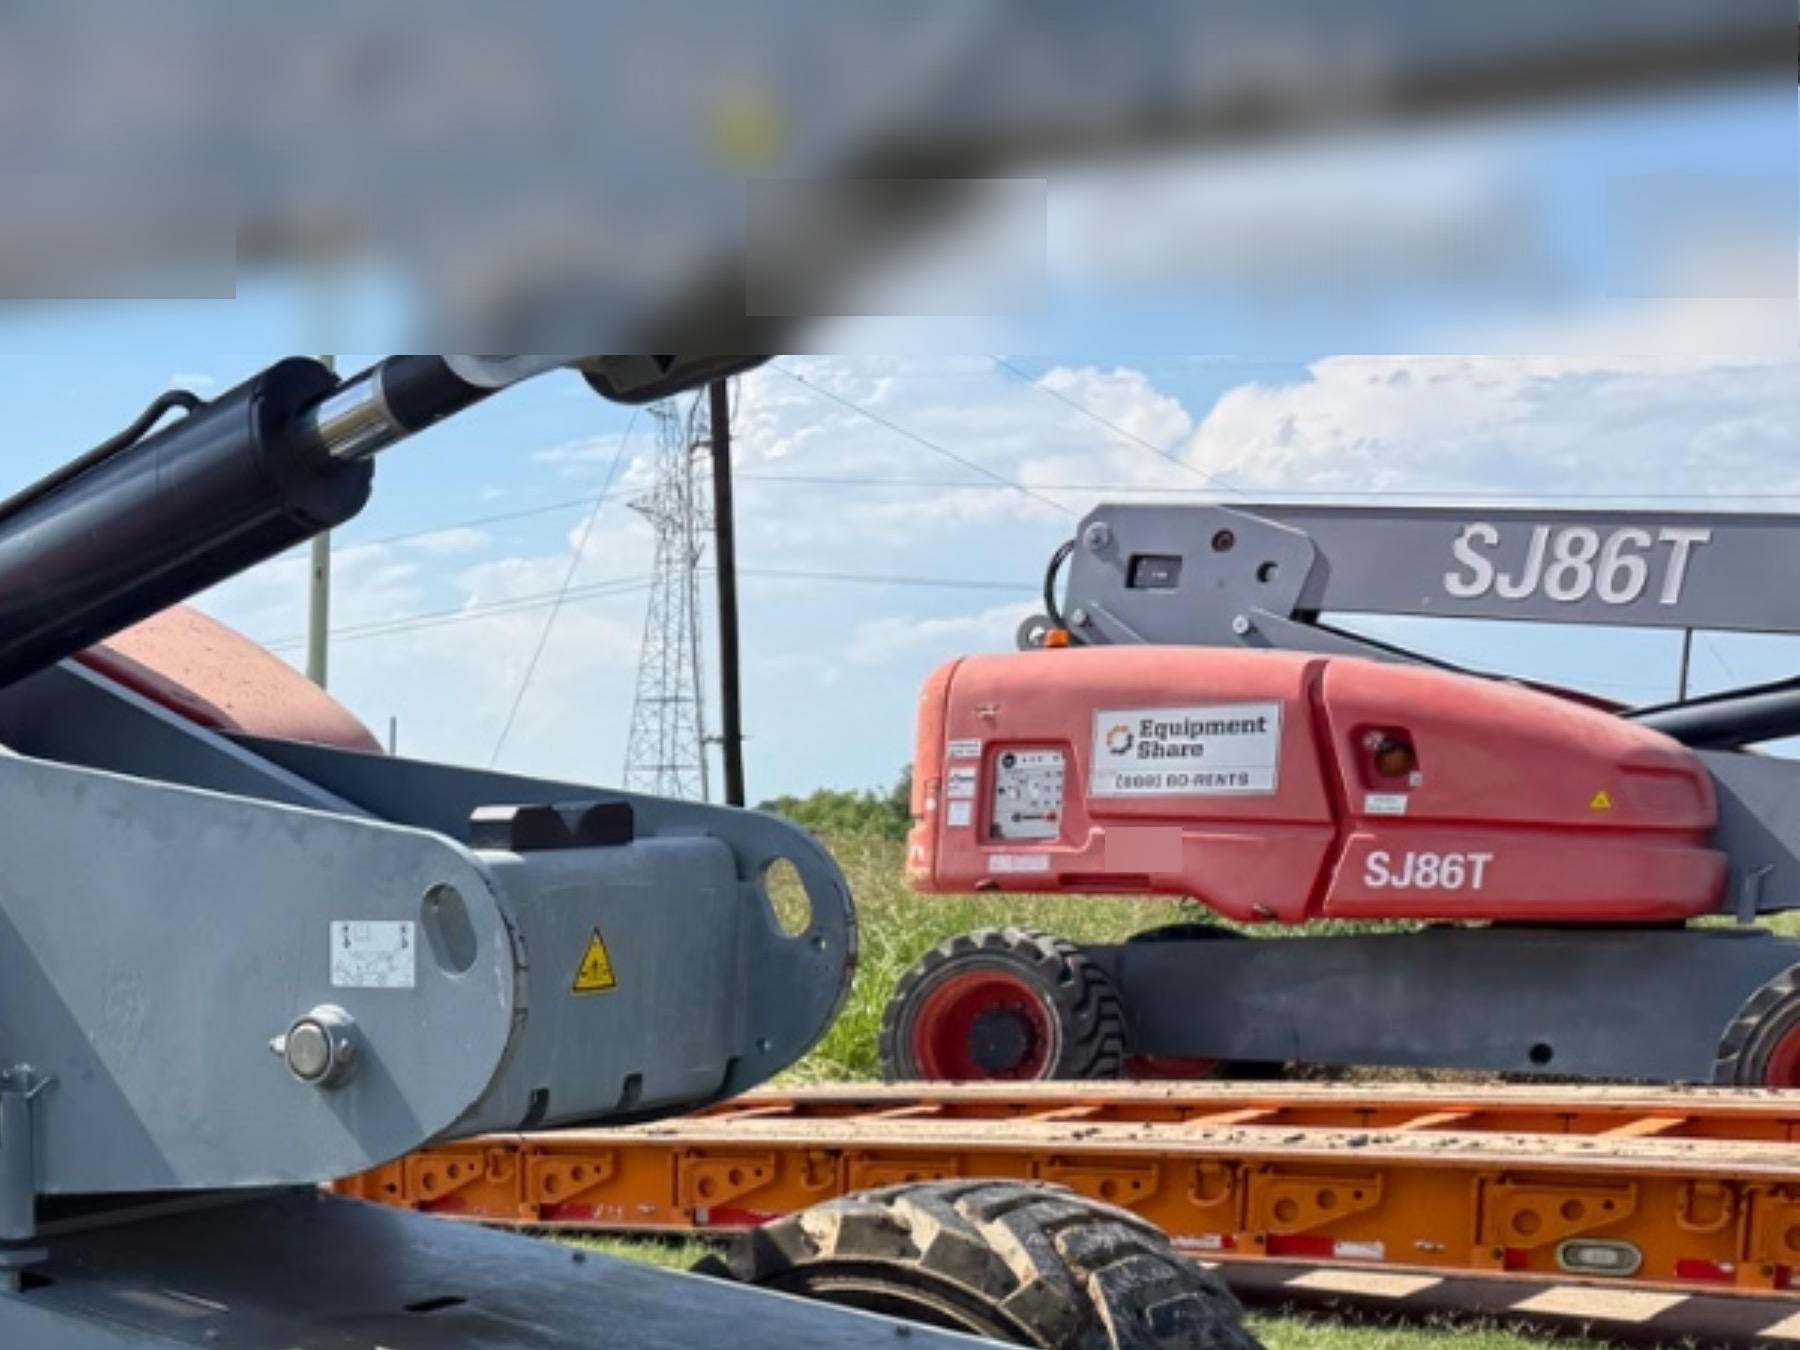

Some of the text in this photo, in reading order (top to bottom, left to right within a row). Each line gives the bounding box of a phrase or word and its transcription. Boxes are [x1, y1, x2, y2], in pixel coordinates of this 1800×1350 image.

[1443, 522, 1712, 604] SJ86T
[1138, 715, 1268, 741] Equipment
[1137, 741, 1204, 760] Share
[1363, 850, 1494, 890] SJ86T
